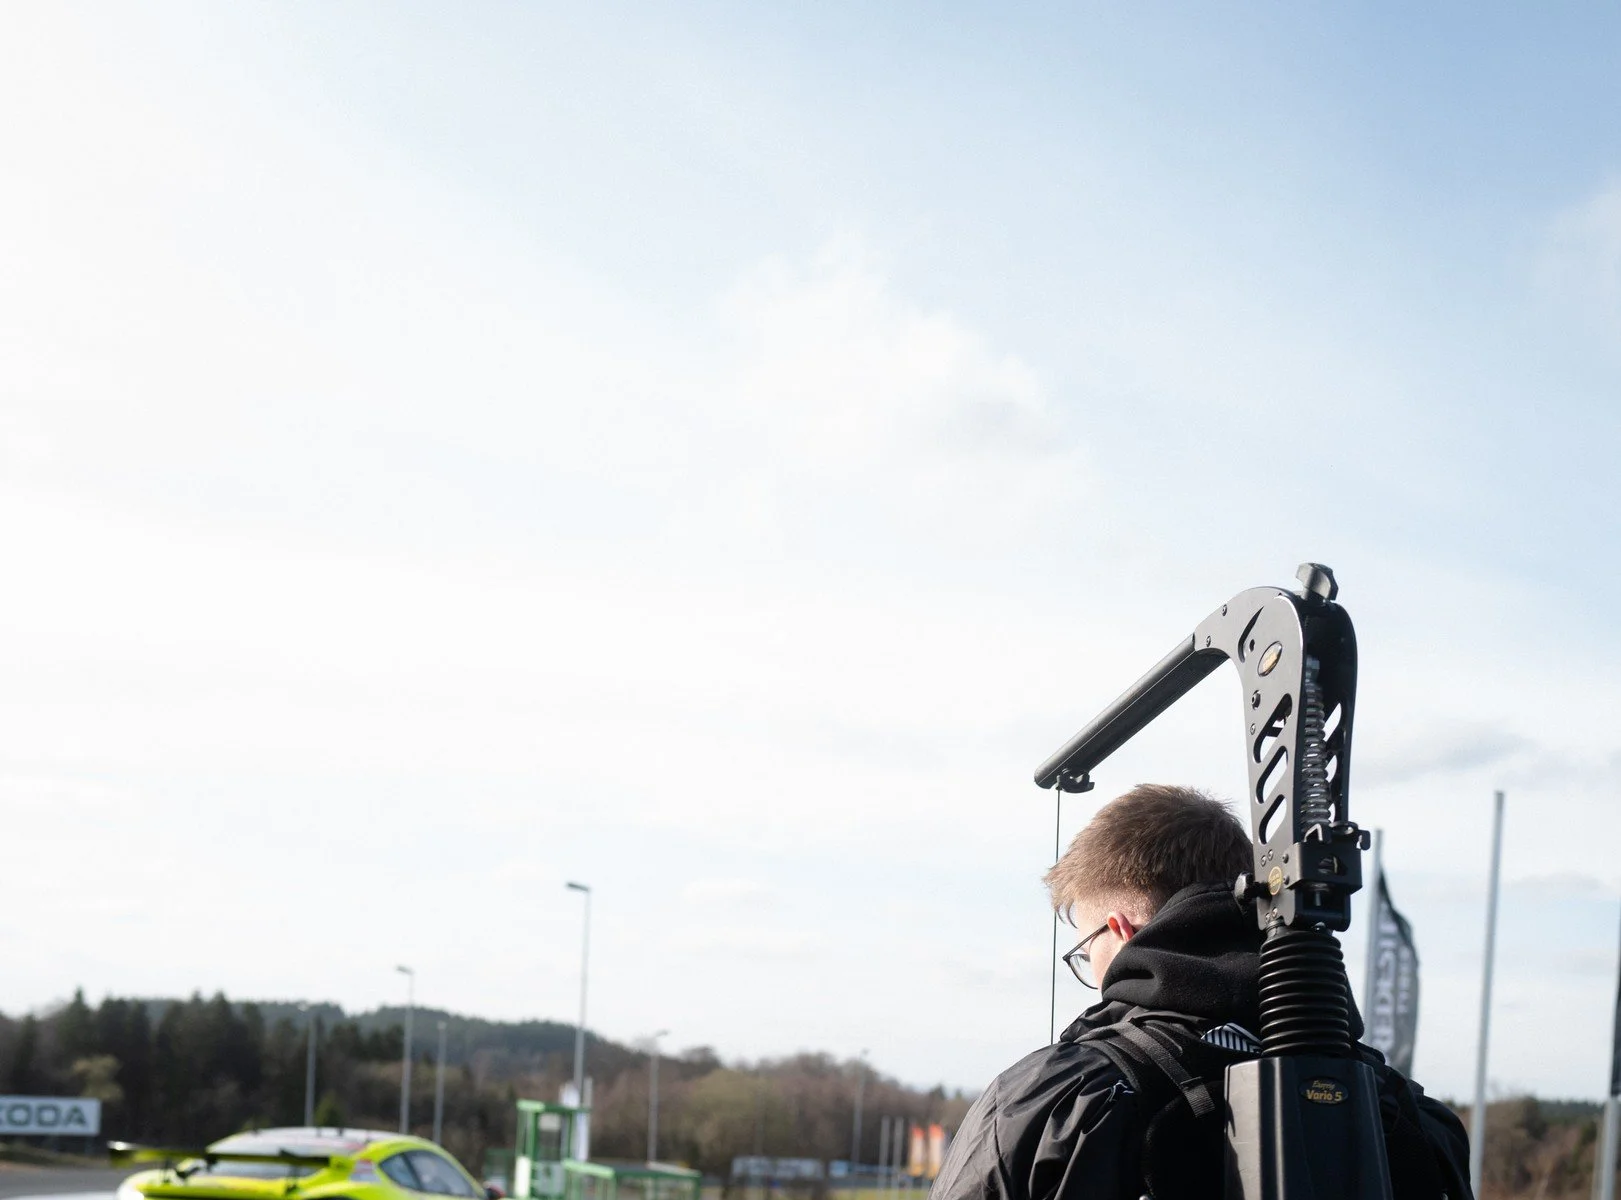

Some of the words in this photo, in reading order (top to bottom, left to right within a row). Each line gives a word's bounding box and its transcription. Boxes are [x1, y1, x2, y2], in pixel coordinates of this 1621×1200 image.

[1306, 1089, 1333, 1100] Vario
[1335, 1091, 1343, 1102] 5
[0, 1104, 86, 1127] ODA
